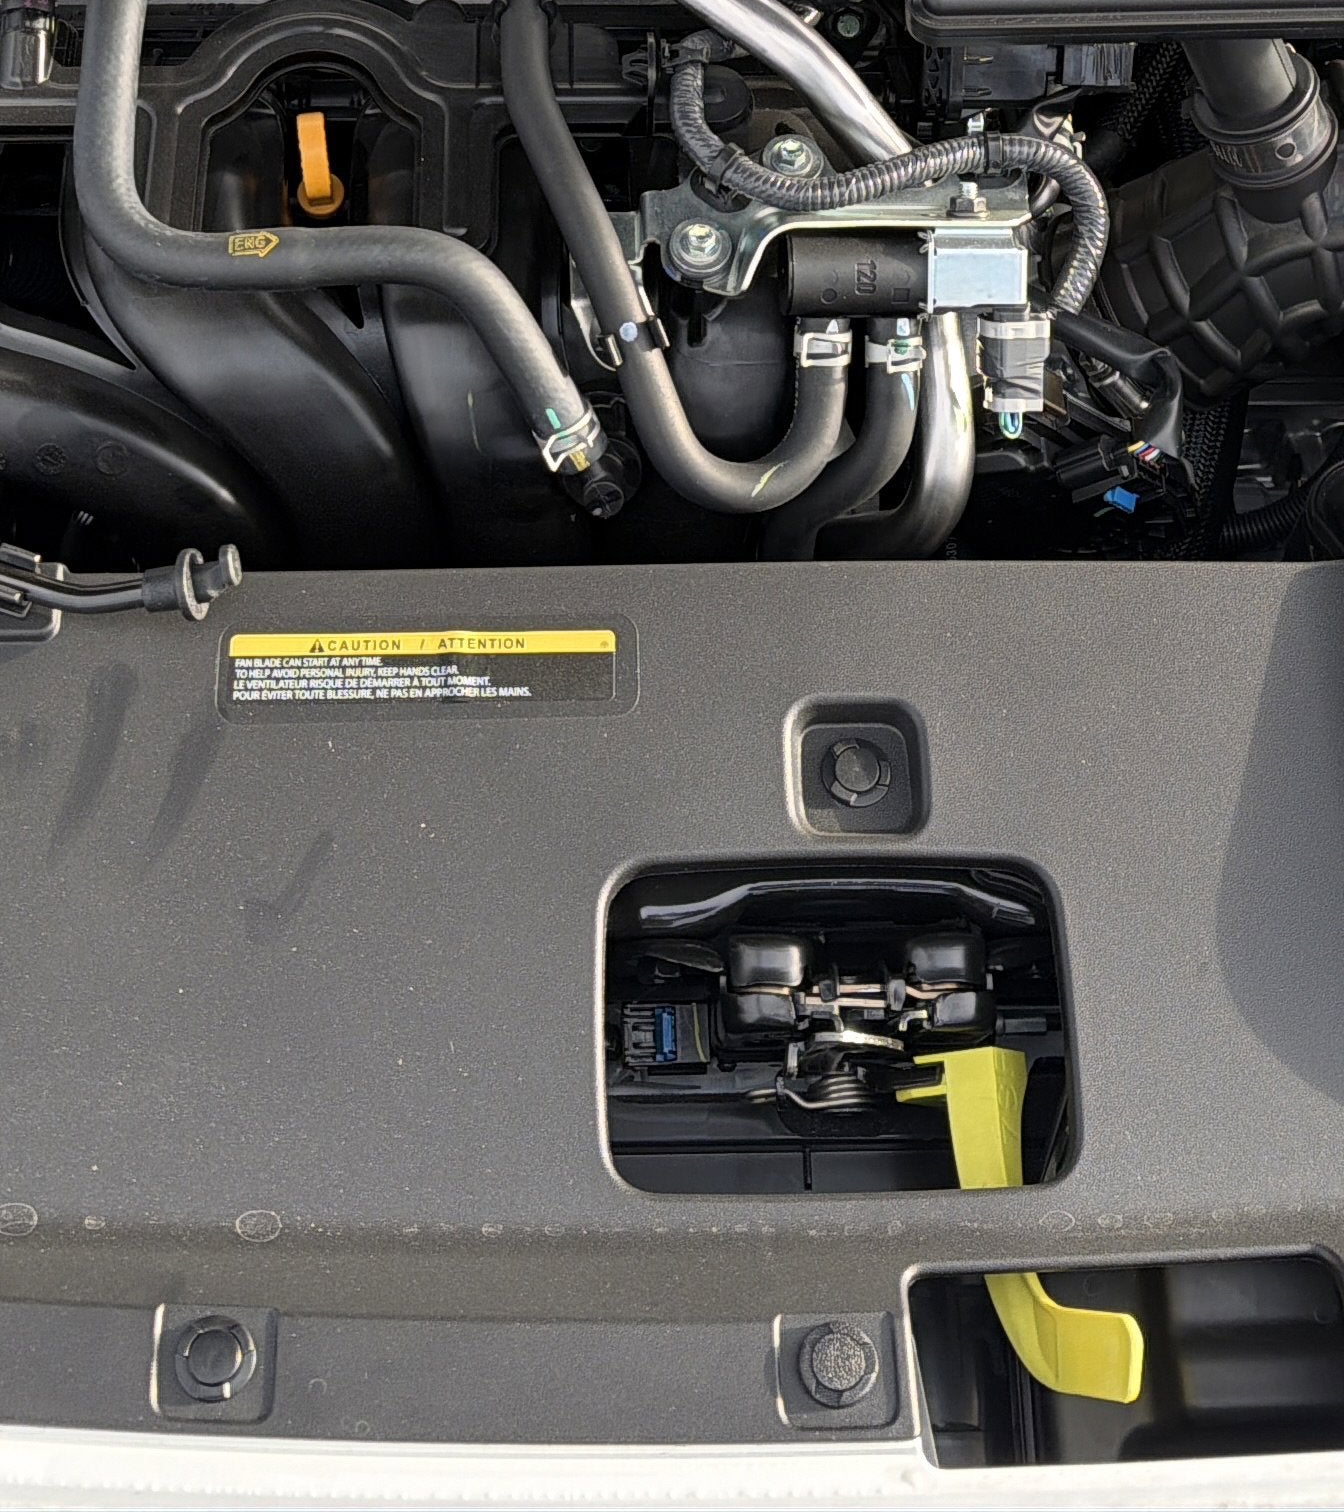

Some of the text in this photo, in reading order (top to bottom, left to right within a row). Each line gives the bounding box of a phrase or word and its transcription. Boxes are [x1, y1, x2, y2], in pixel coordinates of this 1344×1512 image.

[234, 235, 266, 251] ENG
[855, 259, 877, 295] 120
[327, 639, 401, 651] CAUTION
[437, 638, 525, 650] ATTENTION
[235, 658, 254, 667] FAN
[255, 658, 282, 667] BLADE
[283, 657, 302, 666] CAN
[303, 657, 328, 666] START
[329, 657, 340, 666] AT
[235, 670, 248, 678] TO
[249, 670, 270, 678] HELP
[271, 669, 299, 678] AVOID
[301, 668, 344, 678] PERSONAL
[378, 668, 398, 676] KEEP
[400, 667, 430, 676] HANDS
[431, 666, 459, 675] CLEAR.
[234, 680, 245, 689] LE
[246, 680, 308, 689] VENTILATEUR
[309, 679, 343, 689] RISQUE
[345, 679, 358, 688] DE
[422, 677, 446, 686] TOUT
[447, 676, 491, 686] MOMENT.
[233, 687, 532, 700] POUR ÉVITER TOUTE BLESSURE, NE PAS EN APPROCHER LES MAINS.
